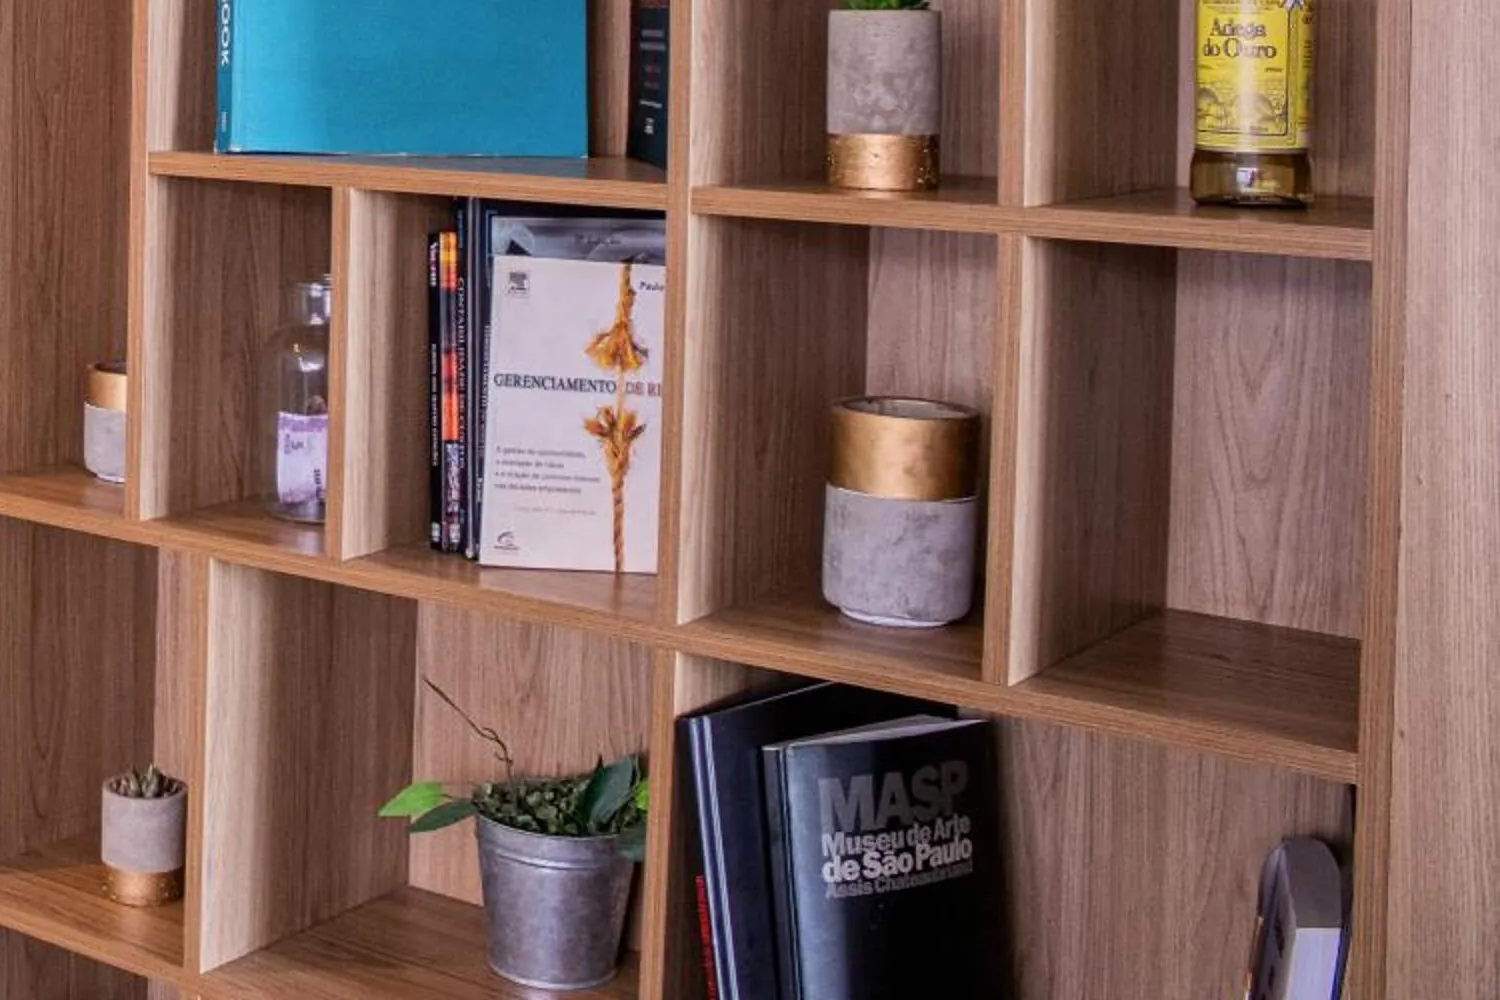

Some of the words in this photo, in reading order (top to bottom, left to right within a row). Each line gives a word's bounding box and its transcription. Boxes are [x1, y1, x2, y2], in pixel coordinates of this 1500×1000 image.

[1202, 39, 1221, 57] do
[493, 373, 617, 395] GERENCIAMENTO
[625, 381, 644, 395] DE
[818, 760, 968, 832] MASP
[822, 830, 904, 857] Museu
[907, 821, 932, 846] de
[933, 813, 972, 841] Arte
[822, 854, 860, 883] de
[863, 850, 914, 879] São
[915, 836, 973, 871] Paulo
